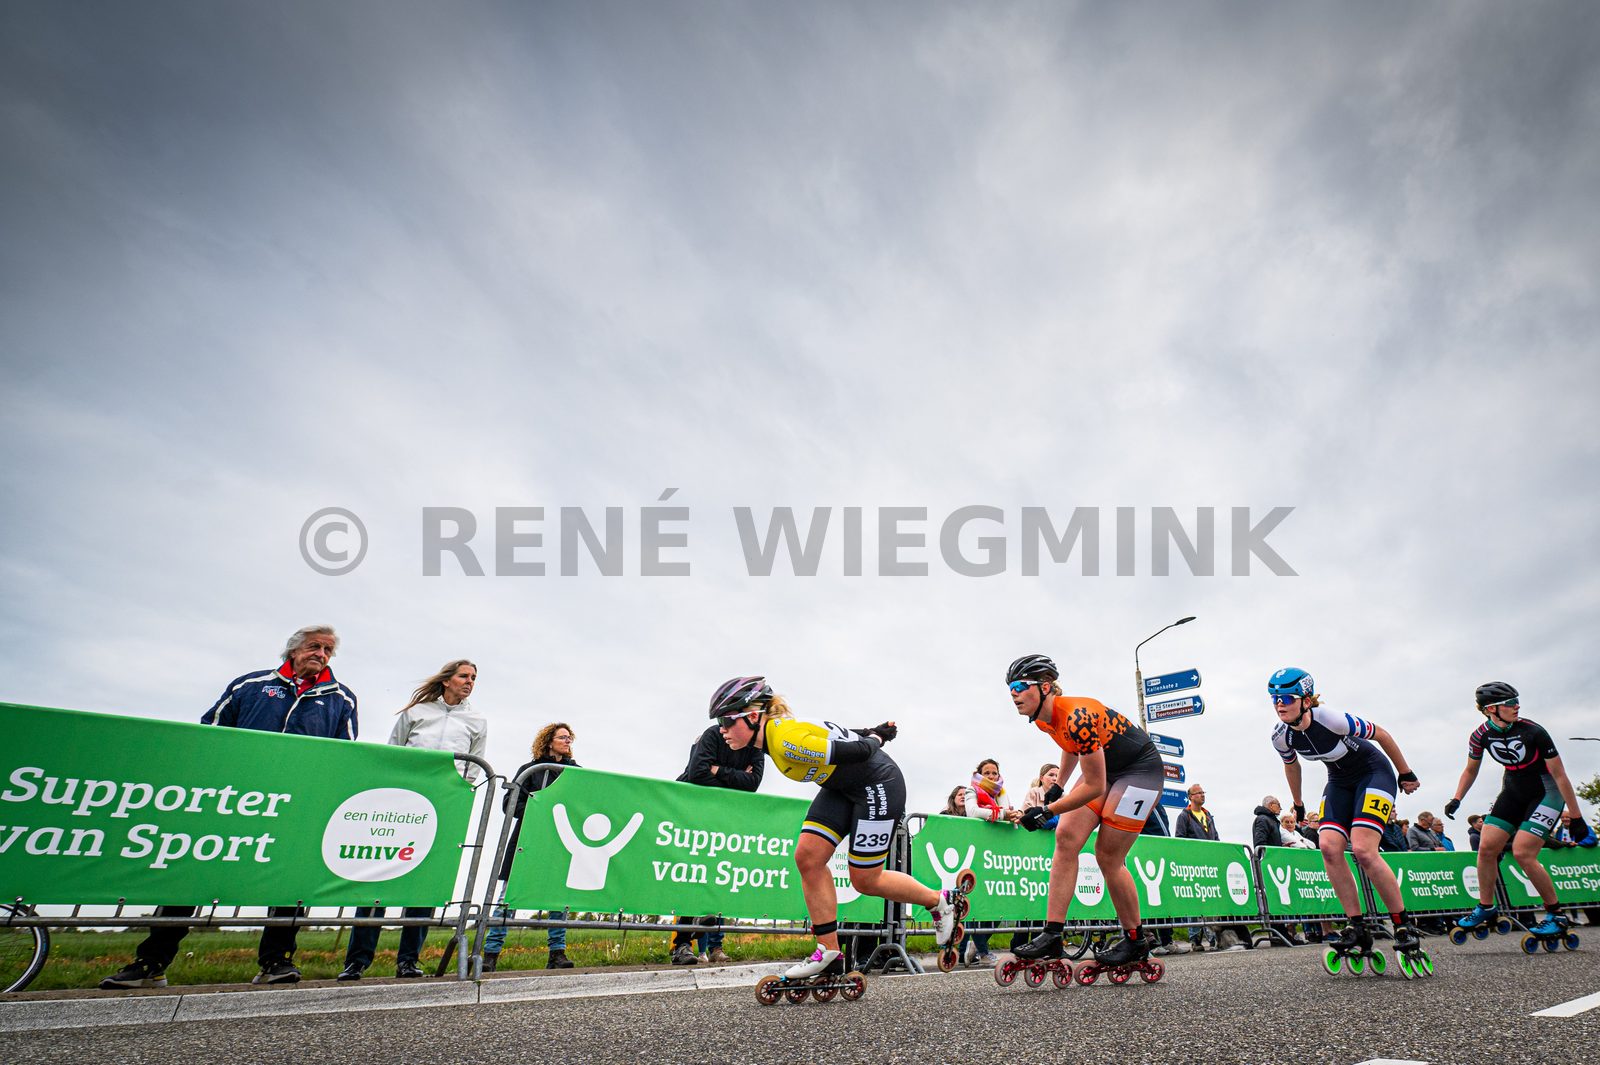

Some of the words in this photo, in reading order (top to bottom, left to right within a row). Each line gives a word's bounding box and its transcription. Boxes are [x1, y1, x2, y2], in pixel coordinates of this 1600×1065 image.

[1162, 700, 1187, 709] Steenwijk
[783, 740, 797, 751] van
[799, 746, 825, 758] Lingen
[785, 751, 820, 764] Skeelers
[1, 766, 292, 818] Supporter
[876, 783, 888, 816] Skeelers
[1134, 800, 1144, 816] 1
[1369, 799, 1390, 816] 18
[344, 811, 368, 821] een
[371, 810, 428, 825] initiatief
[1532, 812, 1554, 826] 276
[370, 827, 395, 837] van
[656, 821, 793, 857] Supporter
[855, 833, 889, 847] 239
[120, 823, 275, 869] Sport
[340, 841, 415, 861] univé
[983, 850, 1053, 876] Supporte
[1550, 864, 1600, 878] Support
[652, 861, 708, 884] van
[715, 861, 790, 893] Sport
[1170, 861, 1218, 882] Supporter
[1295, 868, 1330, 884] Supporte
[1408, 870, 1454, 884] Supporter
[985, 880, 1016, 896] van
[1078, 883, 1100, 894] univé
[1173, 885, 1194, 898] van
[1194, 883, 1222, 902] Sport
[1298, 888, 1315, 898] van
[1412, 887, 1432, 896] van
[1432, 884, 1458, 898] Sport
[1555, 880, 1580, 890] van
